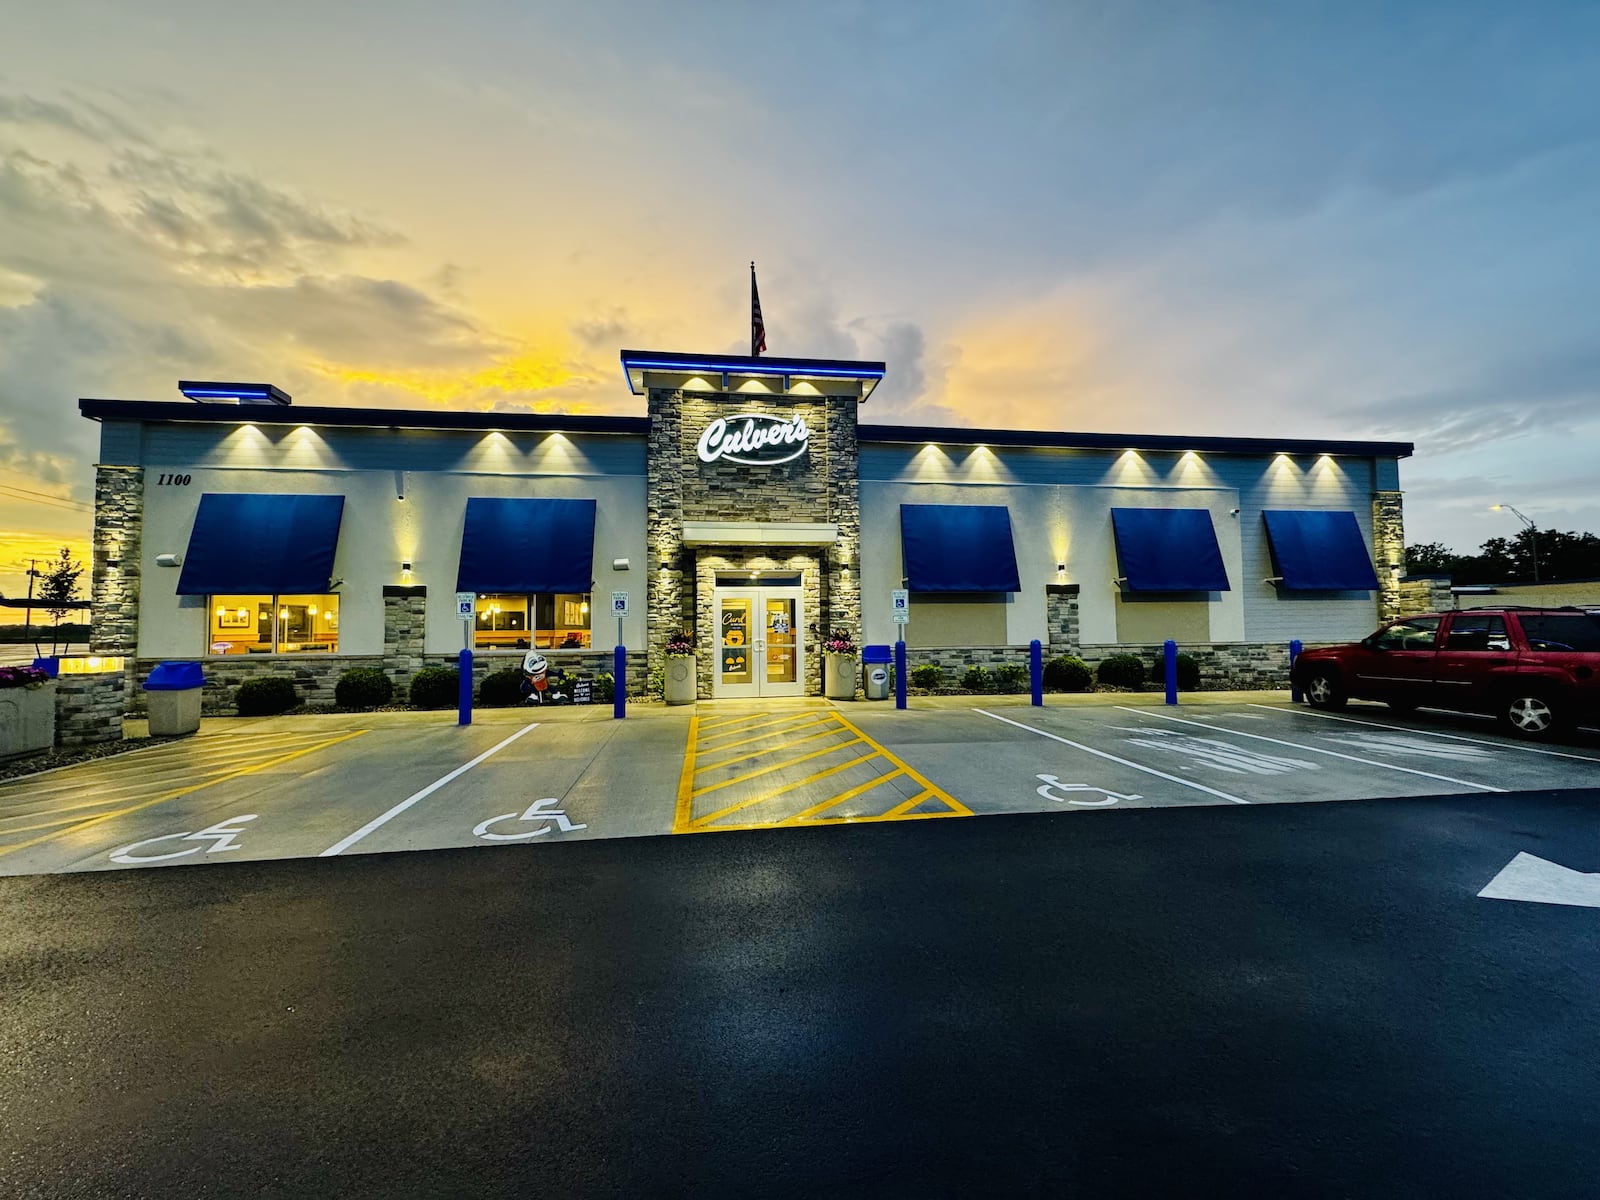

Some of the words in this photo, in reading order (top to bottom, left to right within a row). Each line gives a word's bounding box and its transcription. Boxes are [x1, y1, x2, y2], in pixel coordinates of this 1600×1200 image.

[697, 413, 810, 463] Culver's
[157, 473, 192, 486] 1100
[722, 612, 747, 625] Curd
